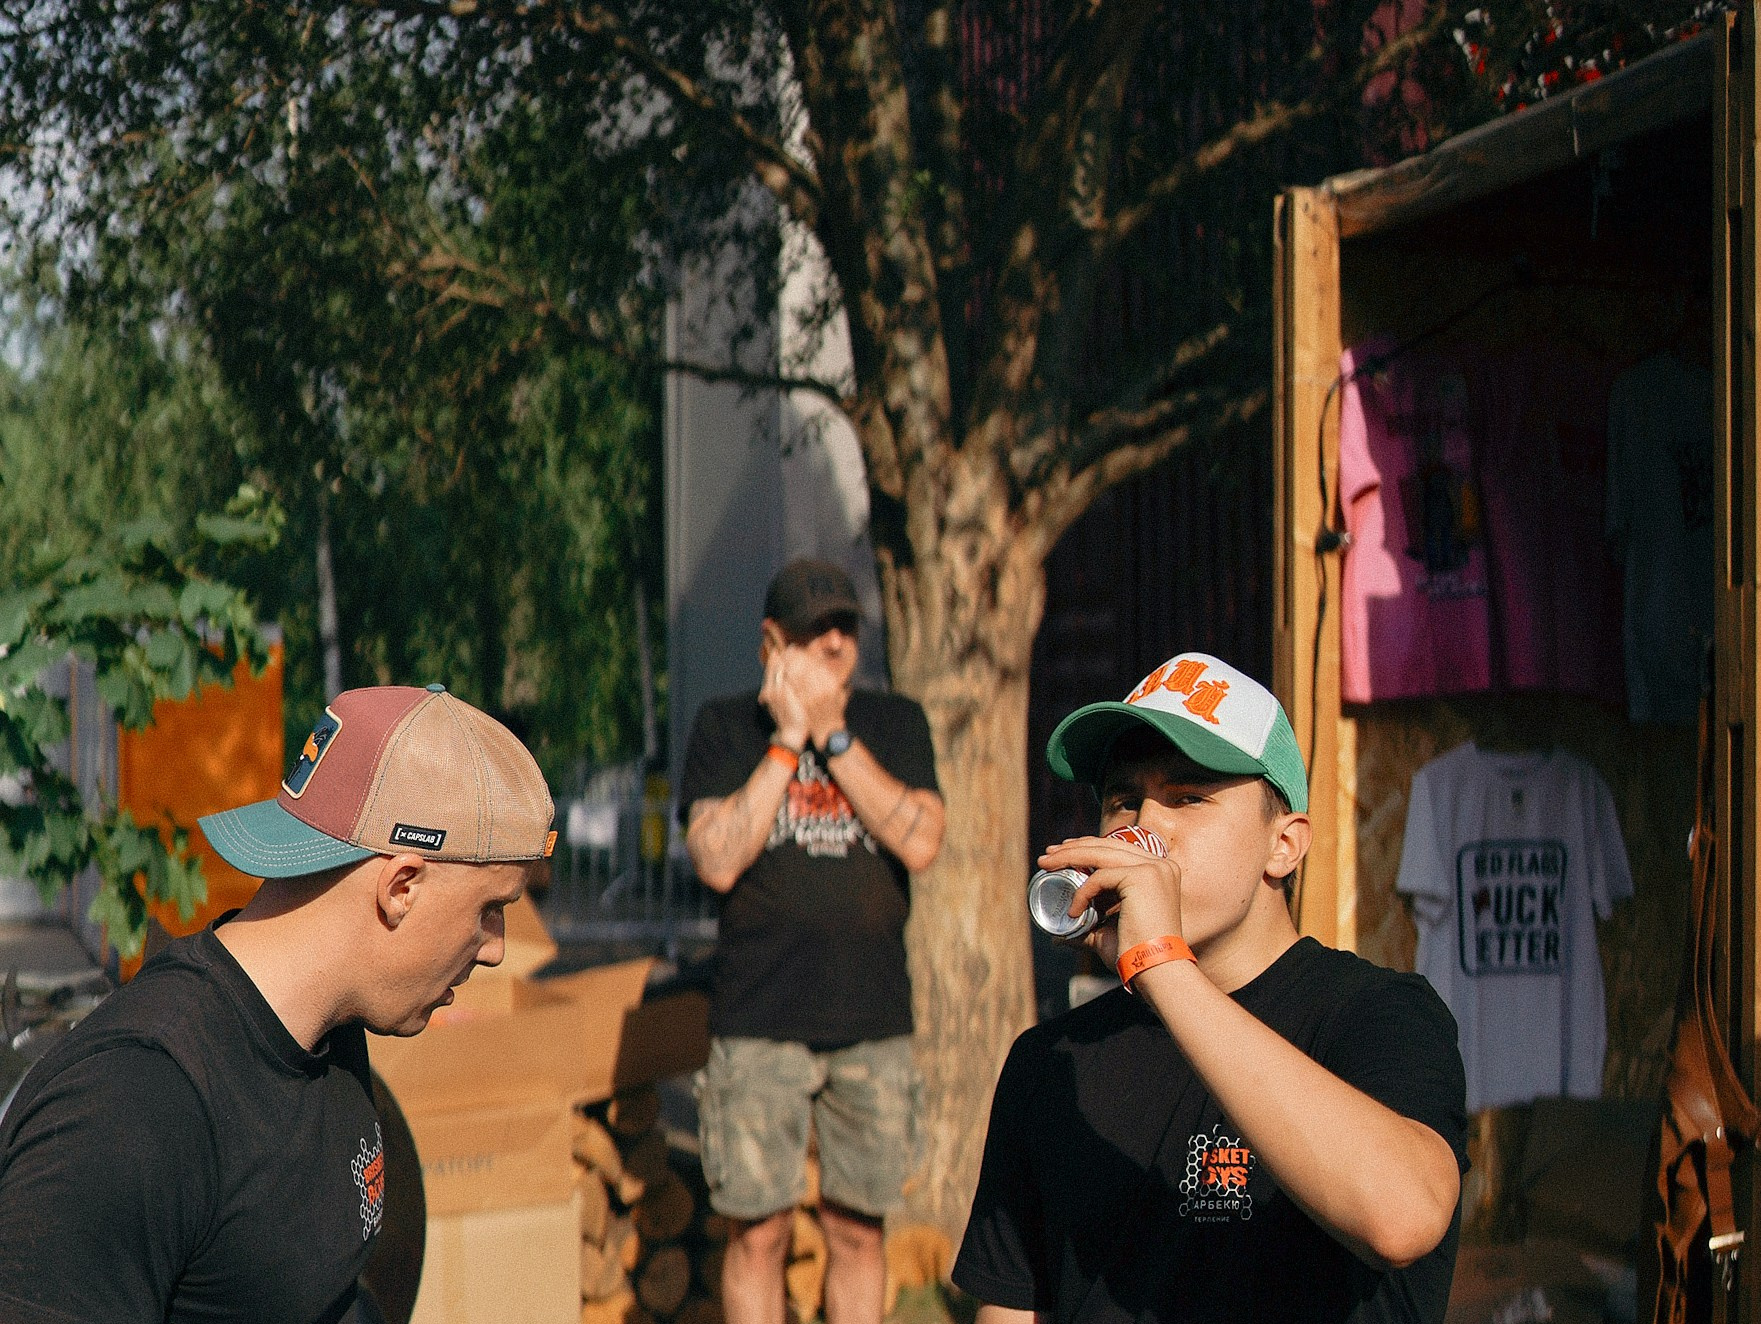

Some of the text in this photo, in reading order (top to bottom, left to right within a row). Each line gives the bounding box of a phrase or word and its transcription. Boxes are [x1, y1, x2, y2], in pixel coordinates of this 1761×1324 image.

[407, 832, 435, 843] CAPSLAB
[1202, 1148, 1250, 1166] SKET
[1194, 1200, 1240, 1210] АРБЕКЮ
